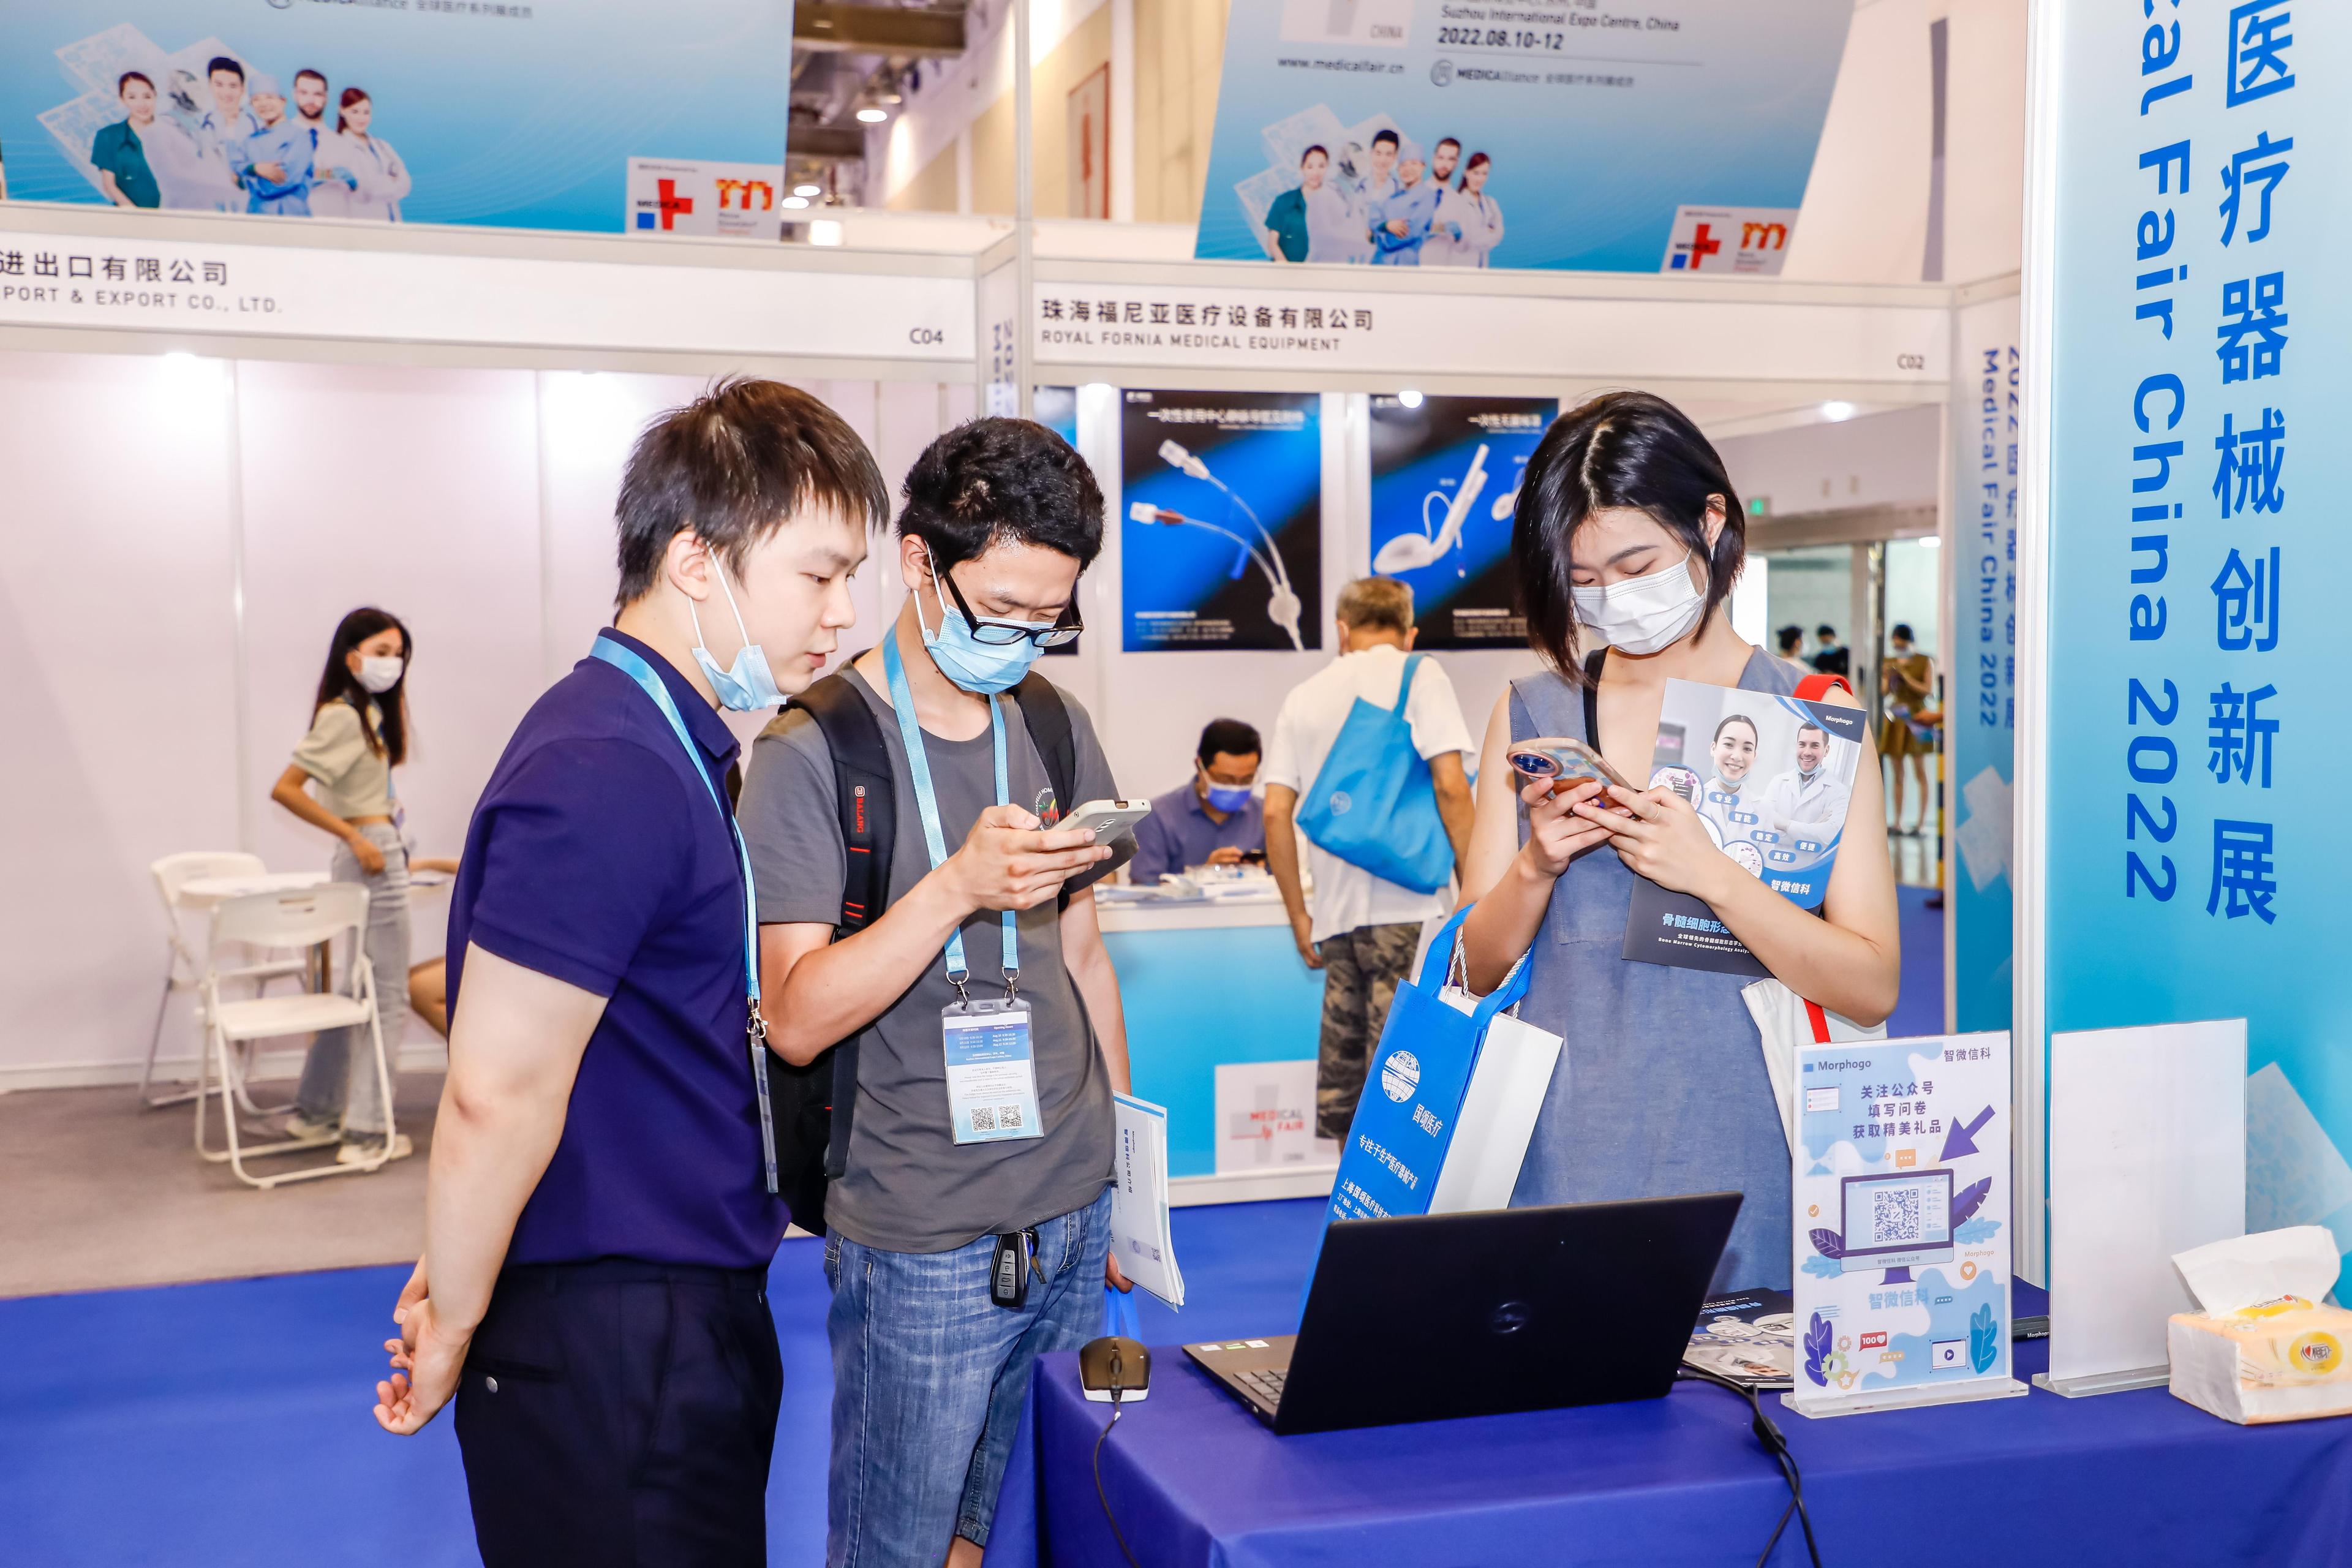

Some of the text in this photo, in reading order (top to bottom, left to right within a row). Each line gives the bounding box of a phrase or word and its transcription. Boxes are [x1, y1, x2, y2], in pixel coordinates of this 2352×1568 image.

[1490, 9, 1566, 24] International
[1569, 13, 1597, 28] Expo
[1646, 17, 1680, 32] China
[1438, 26, 1564, 50] 2022.08.10-12
[2135, 139, 2191, 341] Fair
[0, 250, 228, 287] 进出口有限公司
[70, 288, 83, 304] &
[96, 290, 178, 307] EXPORT
[238, 296, 283, 314] LTD.
[1041, 299, 1374, 331] 珠海福尼亚医疗设备有限公司
[909, 328, 943, 344] C04
[1041, 330, 1341, 352] ROYAL FORNIA MEDICAL EQUIPMENT
[1897, 353, 1924, 371] C02
[2206, 0, 2296, 925] 医疗器械创新展
[2129, 373, 2185, 642] China
[1980, 349, 1999, 727] Medical Fair China 2022
[1825, 715, 1853, 726] Morphogo
[1715, 793, 1733, 804] 专业
[2126, 677, 2179, 903] 2022
[1734, 813, 1752, 824] 智能
[1755, 832, 1773, 843] 稳定
[1800, 841, 1816, 852] 便捷
[1773, 851, 1790, 862] 高效
[1771, 879, 1811, 895] 智微信科
[1694, 943, 1733, 952] Cytomorphology
[1943, 1047, 1991, 1063] 智微信科
[1818, 1059, 1871, 1072] Morphogo
[1860, 1080, 1934, 1100] 关注公众号
[1868, 1101, 1926, 1118] 填写问卷
[1412, 1102, 1443, 1138] 国颂医疗
[1853, 1119, 1941, 1140] 获取精美礼品
[1359, 1134, 1419, 1190] 专注于生产医疗器械产品
[1964, 1250, 1994, 1258] Morphogo
[1869, 1288, 1929, 1310] 智微信科
[1862, 1336, 1877, 1344] 100
